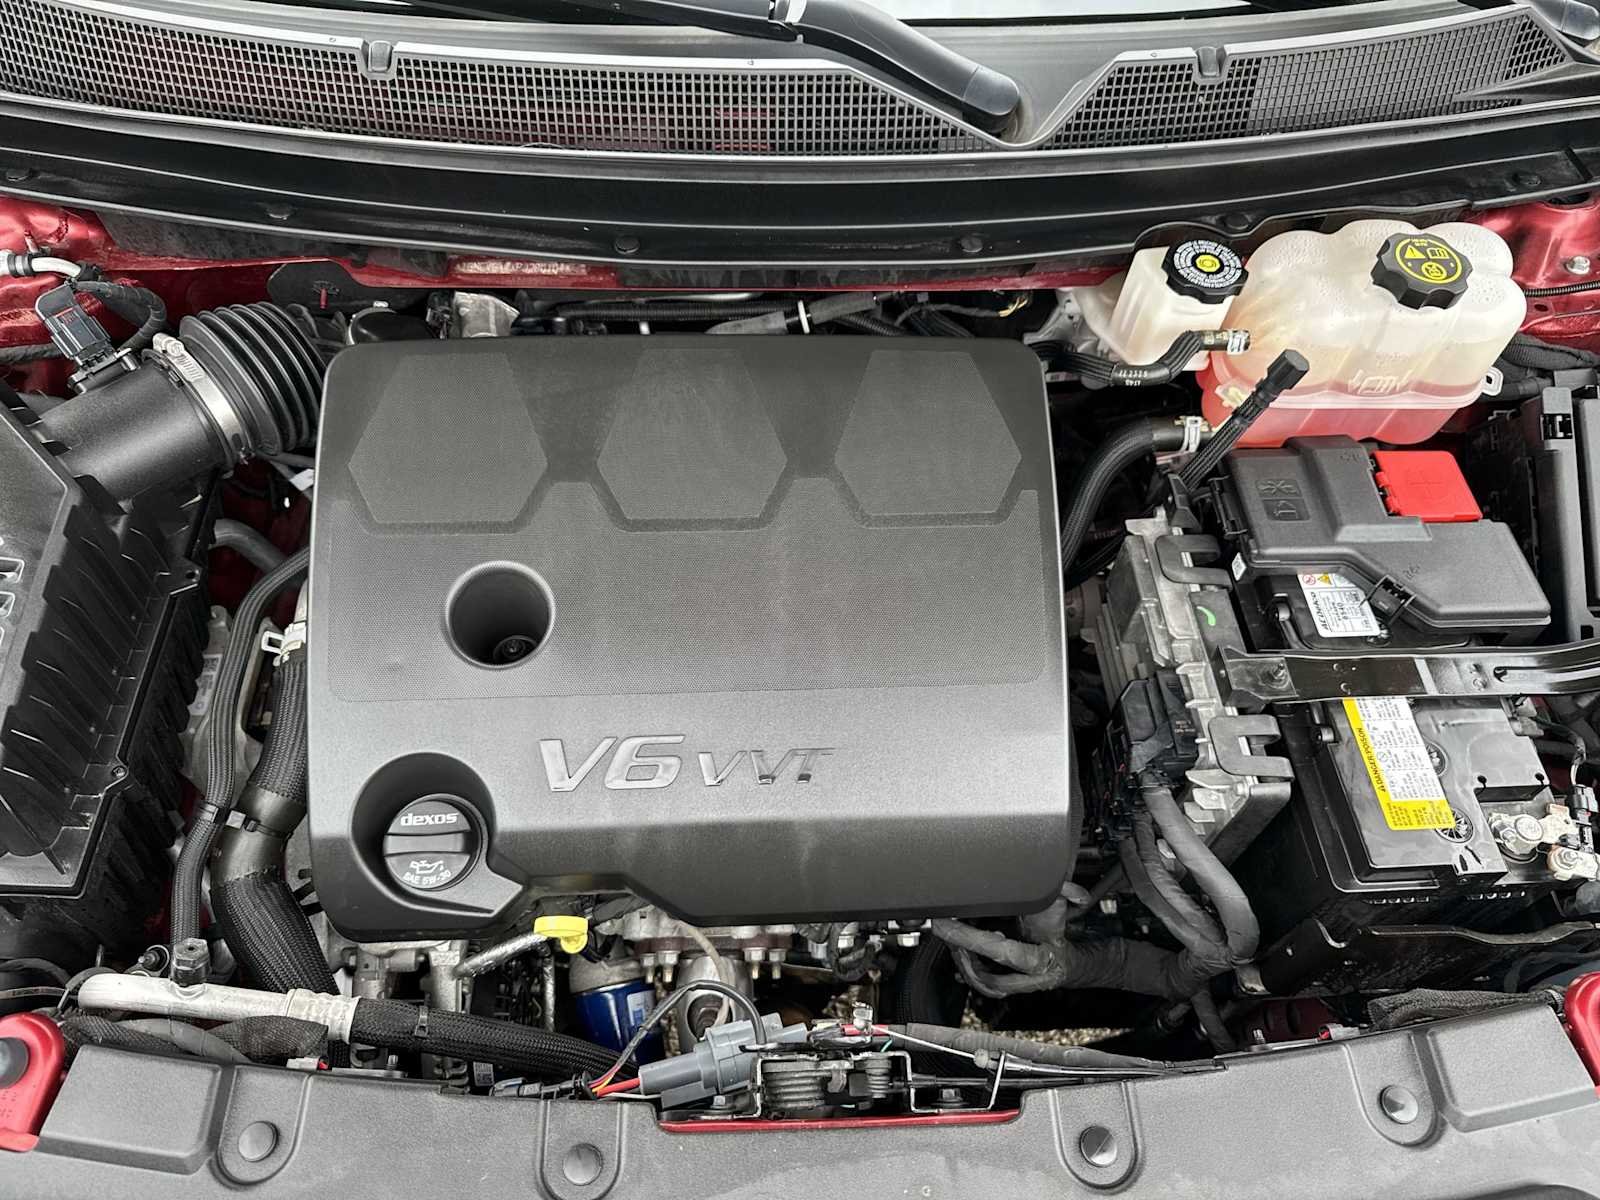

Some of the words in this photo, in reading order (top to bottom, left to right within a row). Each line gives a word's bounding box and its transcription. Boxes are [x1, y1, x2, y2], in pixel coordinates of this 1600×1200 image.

[538, 734, 686, 792] V6
[698, 747, 836, 787] VVT
[400, 812, 460, 826] dexos
[403, 871, 421, 885] SAE
